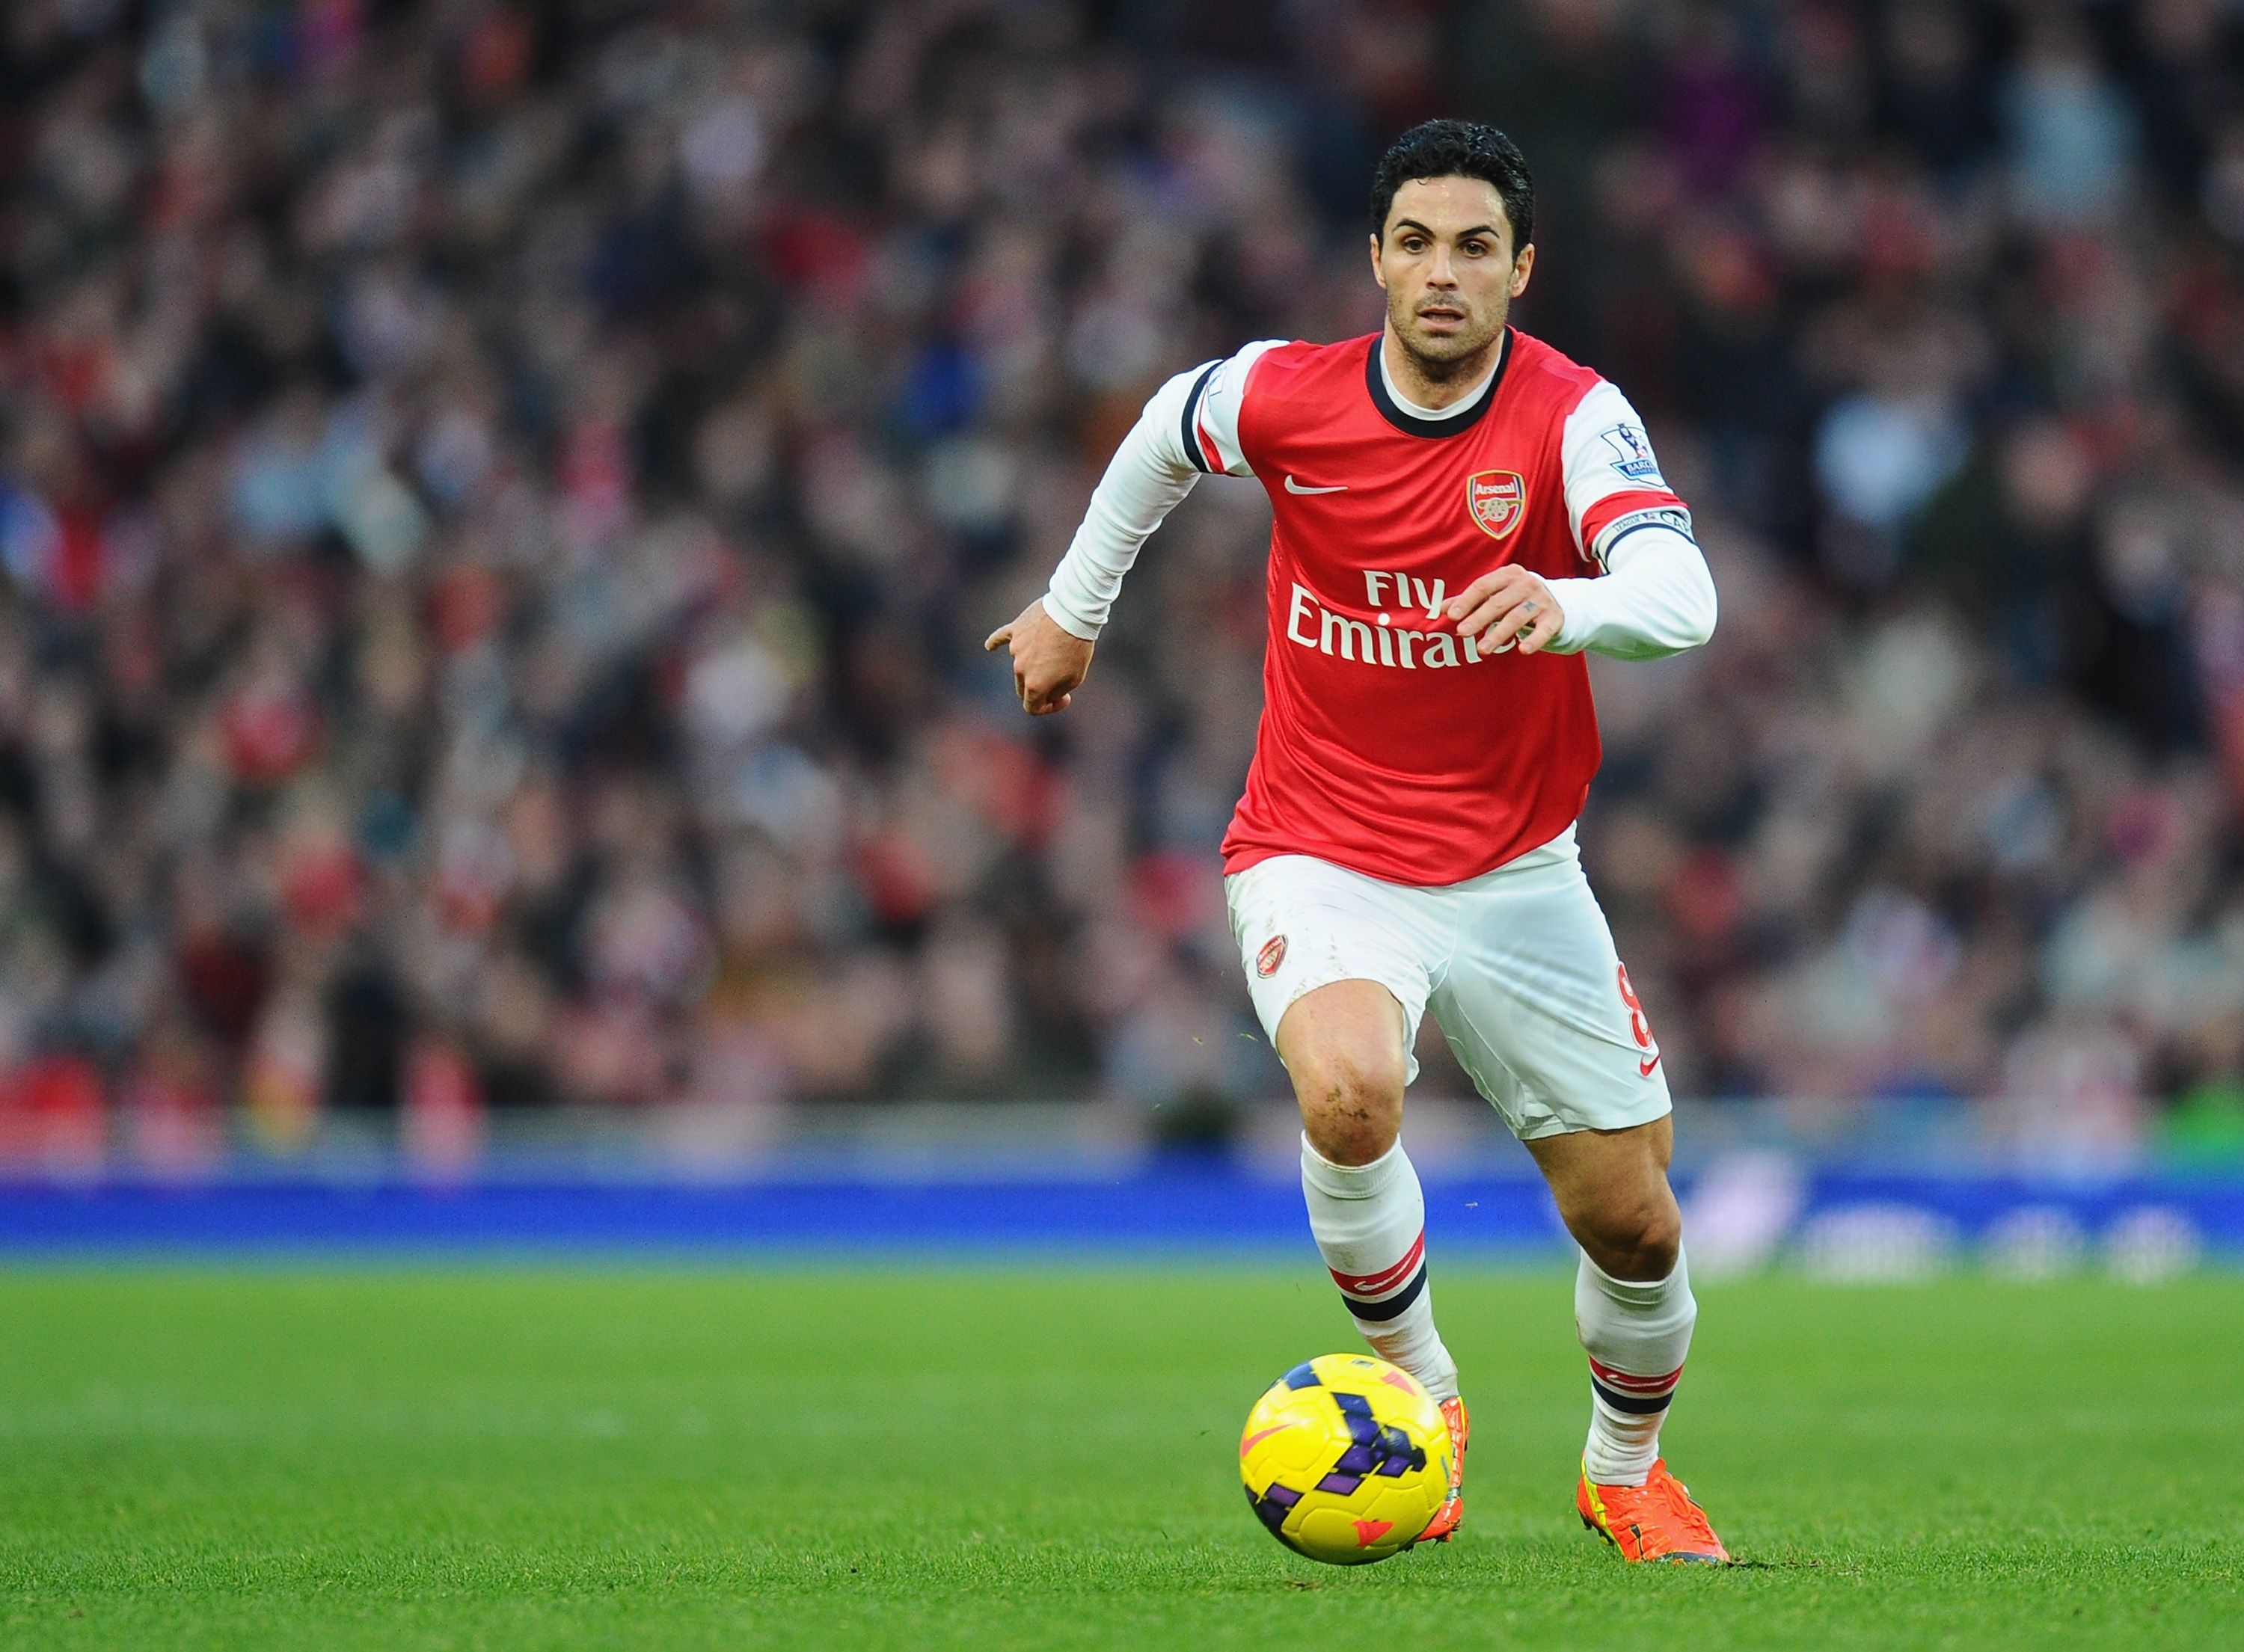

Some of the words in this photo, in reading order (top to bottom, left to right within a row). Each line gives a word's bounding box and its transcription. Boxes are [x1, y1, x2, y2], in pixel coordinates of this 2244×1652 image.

[1476, 482, 1515, 494] Arsenal
[1363, 570, 1445, 620] Fly
[1617, 962, 1652, 1048] 8
